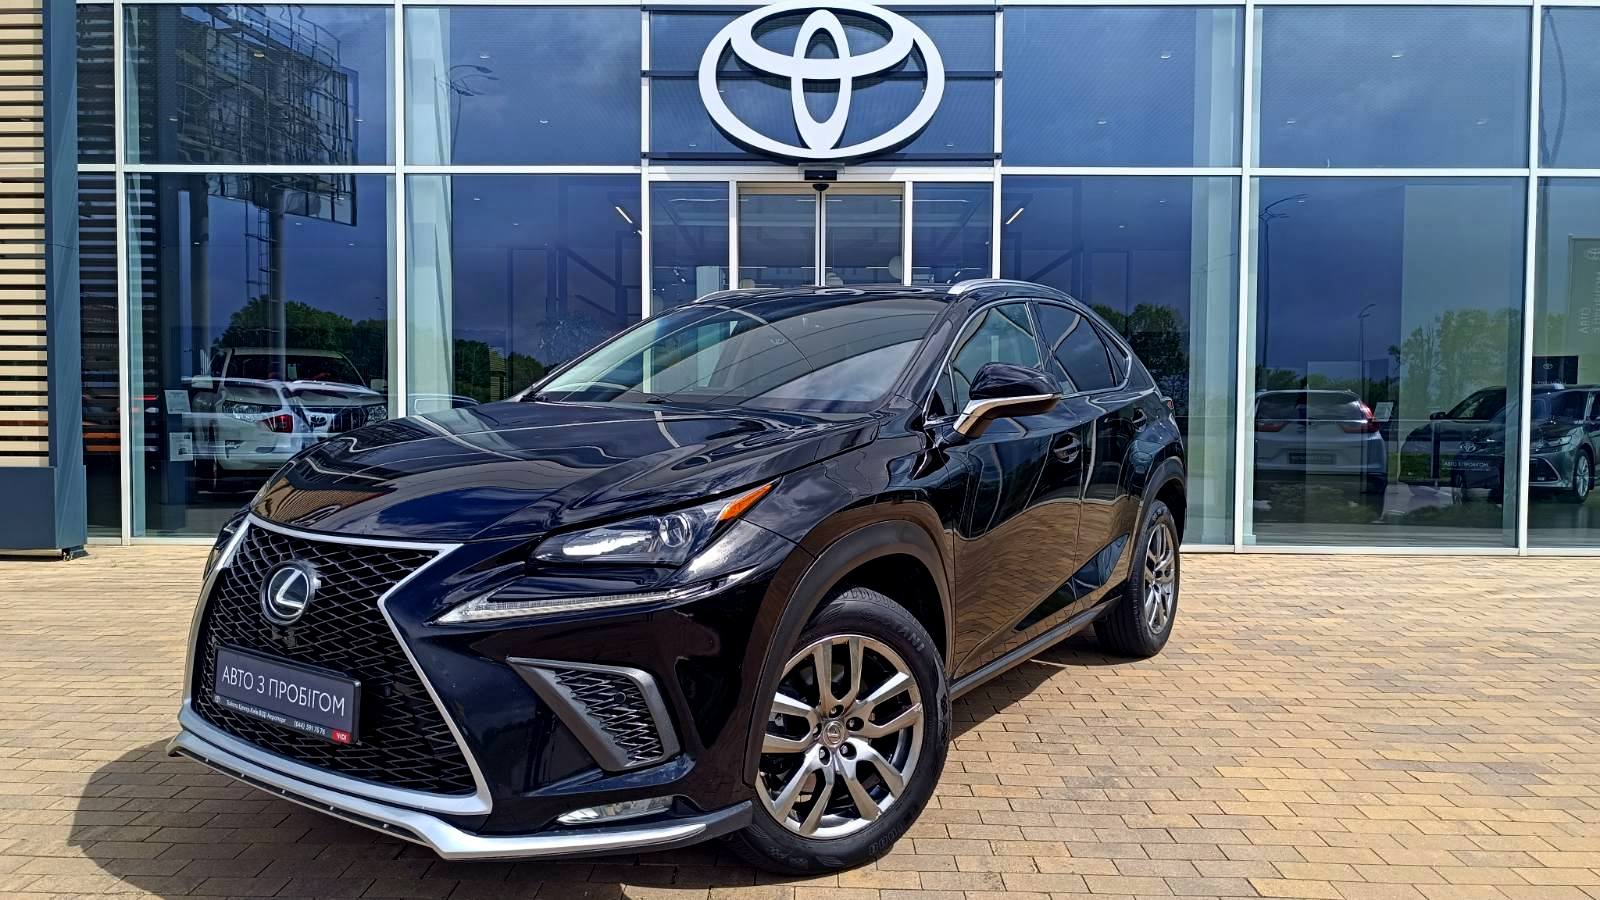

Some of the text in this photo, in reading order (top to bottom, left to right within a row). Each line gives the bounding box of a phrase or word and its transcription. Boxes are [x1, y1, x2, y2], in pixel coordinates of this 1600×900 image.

[221, 665, 345, 717] АВТО З ПРОБІГОМ
